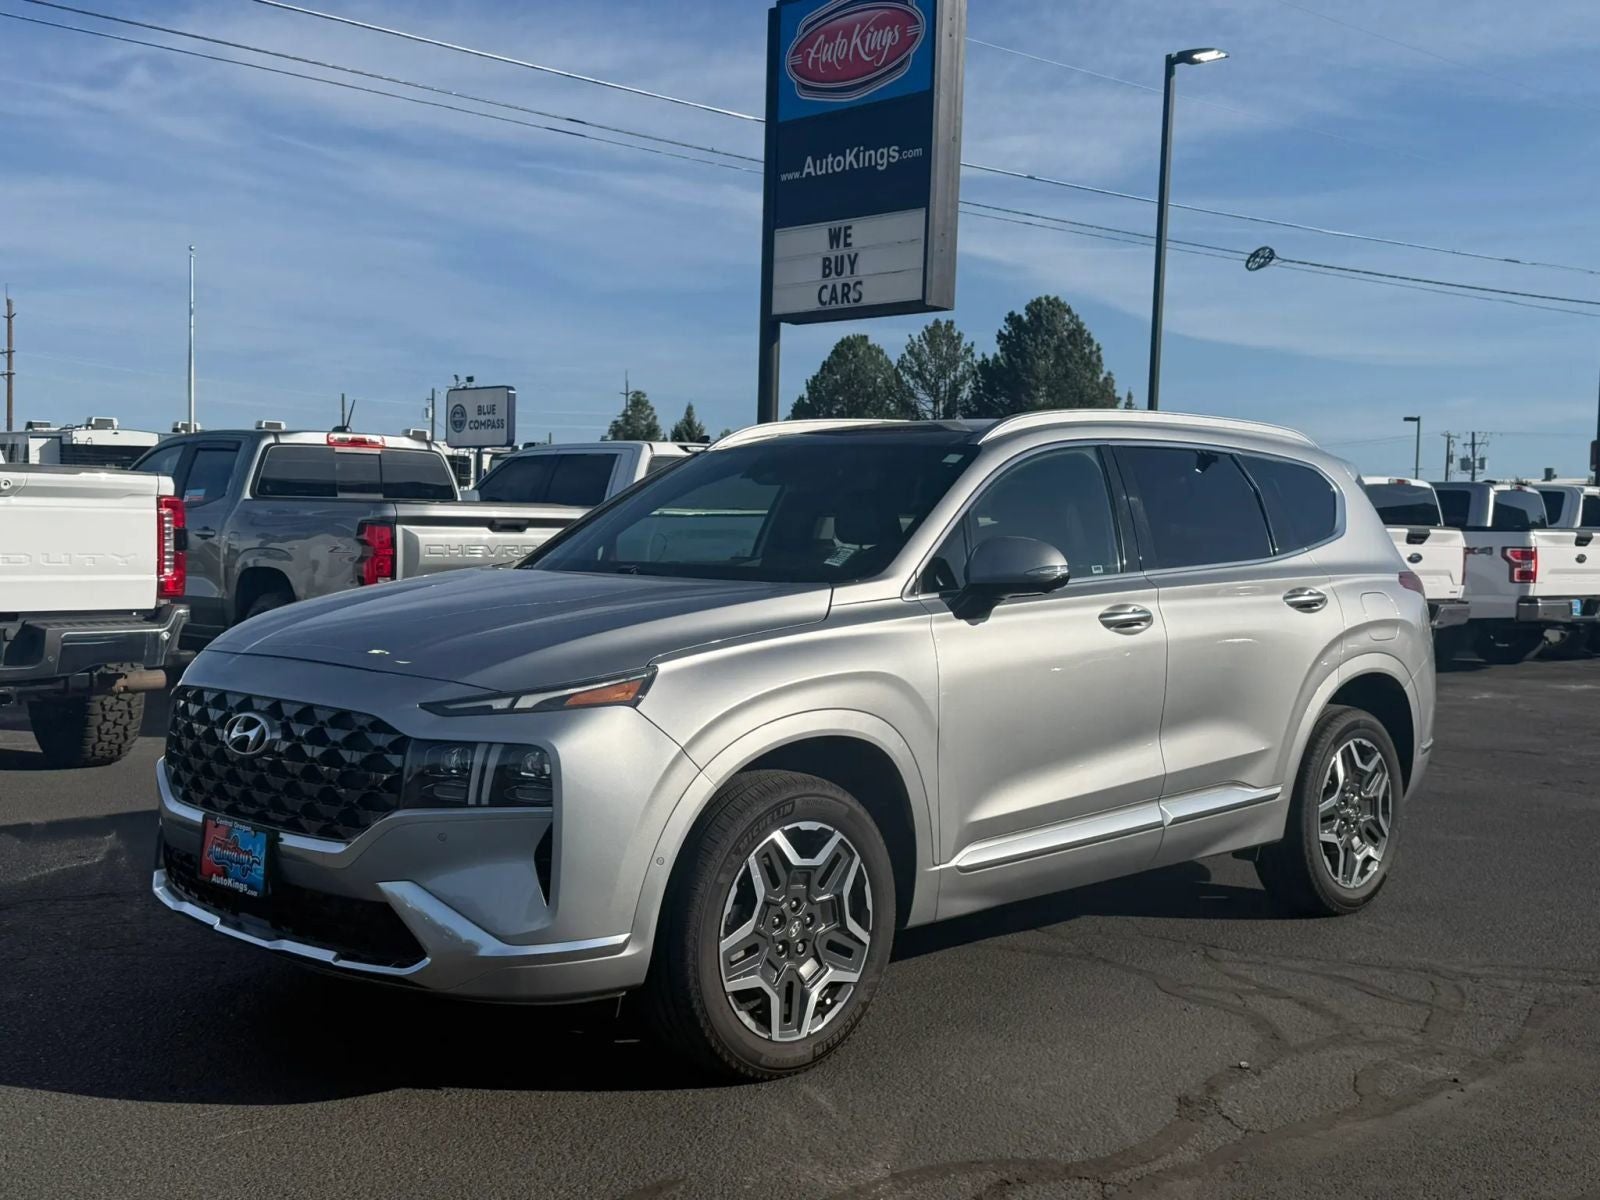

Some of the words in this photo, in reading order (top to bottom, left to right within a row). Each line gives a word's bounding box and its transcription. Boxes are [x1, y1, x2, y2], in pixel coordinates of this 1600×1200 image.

[780, 146, 922, 181] www.AutoKings.com
[828, 225, 852, 249] WE
[822, 252, 858, 278] BUY
[818, 280, 863, 306] CARS
[477, 404, 496, 416] BLUE
[468, 419, 504, 430] COMPASS
[0, 552, 137, 566] DUTY
